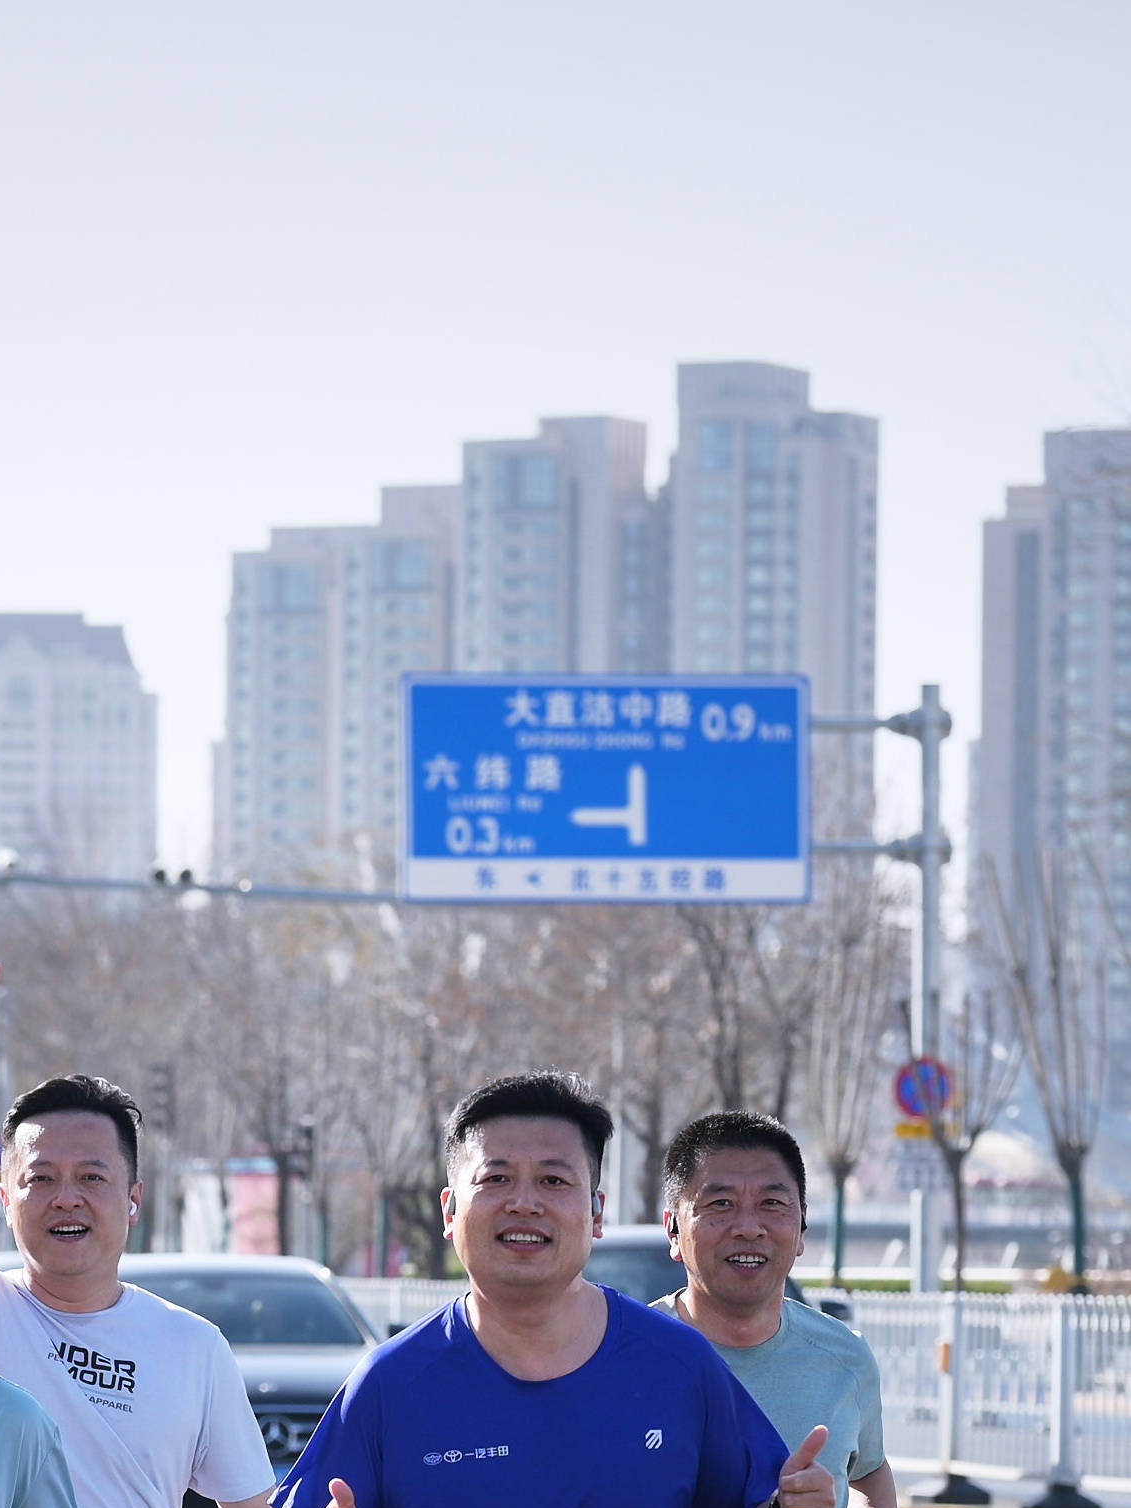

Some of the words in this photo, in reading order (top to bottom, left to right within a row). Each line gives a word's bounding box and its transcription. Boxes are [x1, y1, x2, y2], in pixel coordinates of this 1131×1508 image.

[504, 690, 691, 728] 大直沽中路
[701, 703, 756, 741] 0.9
[423, 754, 561, 791] 六纬路
[446, 817, 499, 854] 0.3
[50, 1340, 136, 1378] NDER
[68, 1366, 136, 1394] OUR
[88, 1395, 134, 1413] APPAREL
[465, 1445, 509, 1459] 一汽丰田
